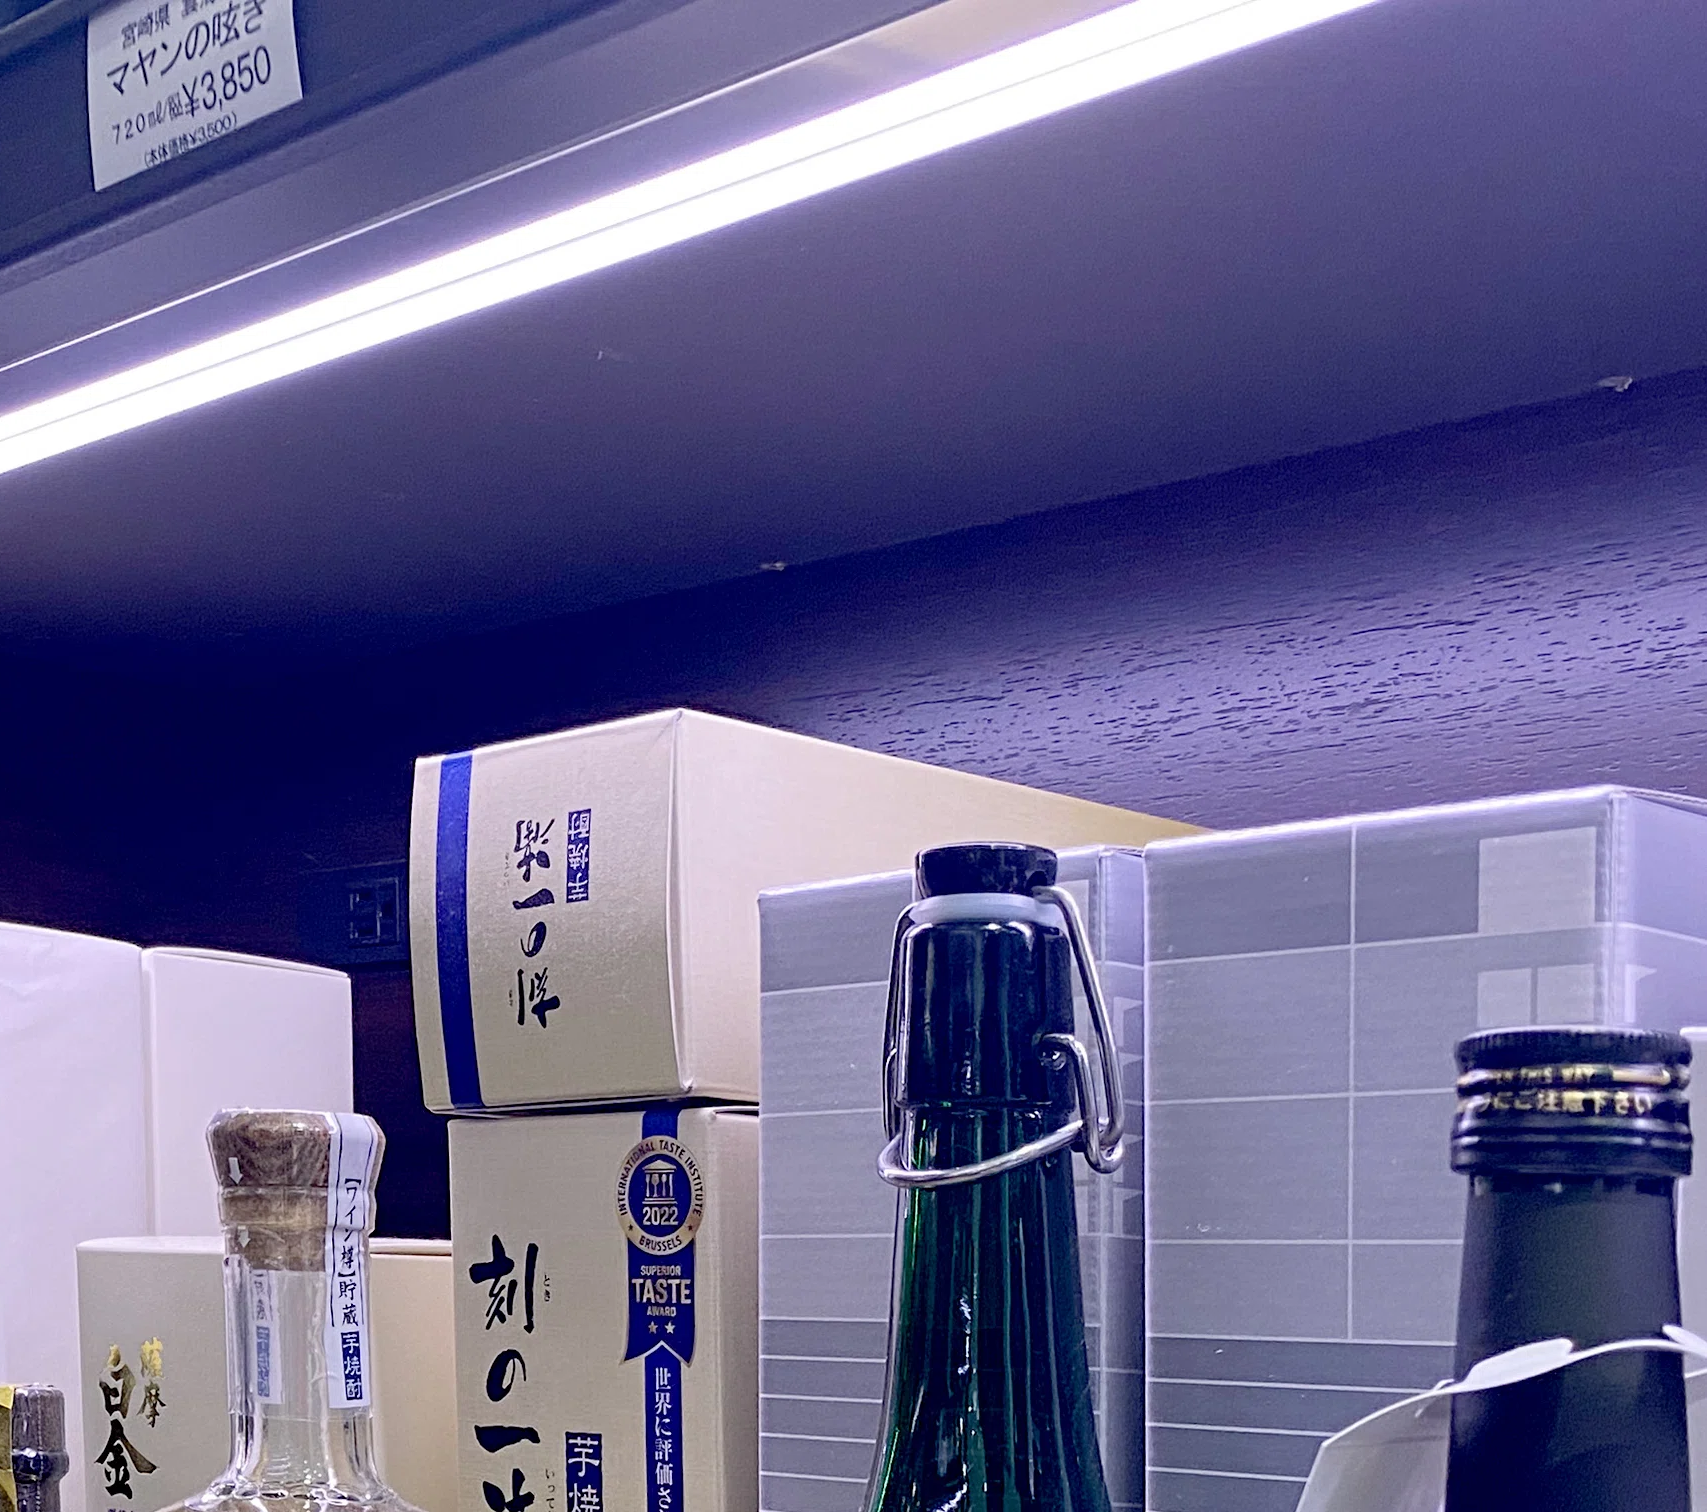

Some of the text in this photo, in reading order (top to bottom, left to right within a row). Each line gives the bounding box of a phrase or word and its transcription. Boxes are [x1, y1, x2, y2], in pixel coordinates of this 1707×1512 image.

[617, 1139, 704, 1217] INTERNATIONAL TASTE INSTITUTE
[642, 1206, 680, 1227] 2022
[639, 1234, 683, 1252] BRUSSELS
[640, 1264, 682, 1277] SUPERIOR
[631, 1278, 692, 1305] TASTE
[646, 1305, 677, 1317] AWARD
[341, 1331, 364, 1401] 芋焼酎
[93, 1343, 160, 1500] 白金
